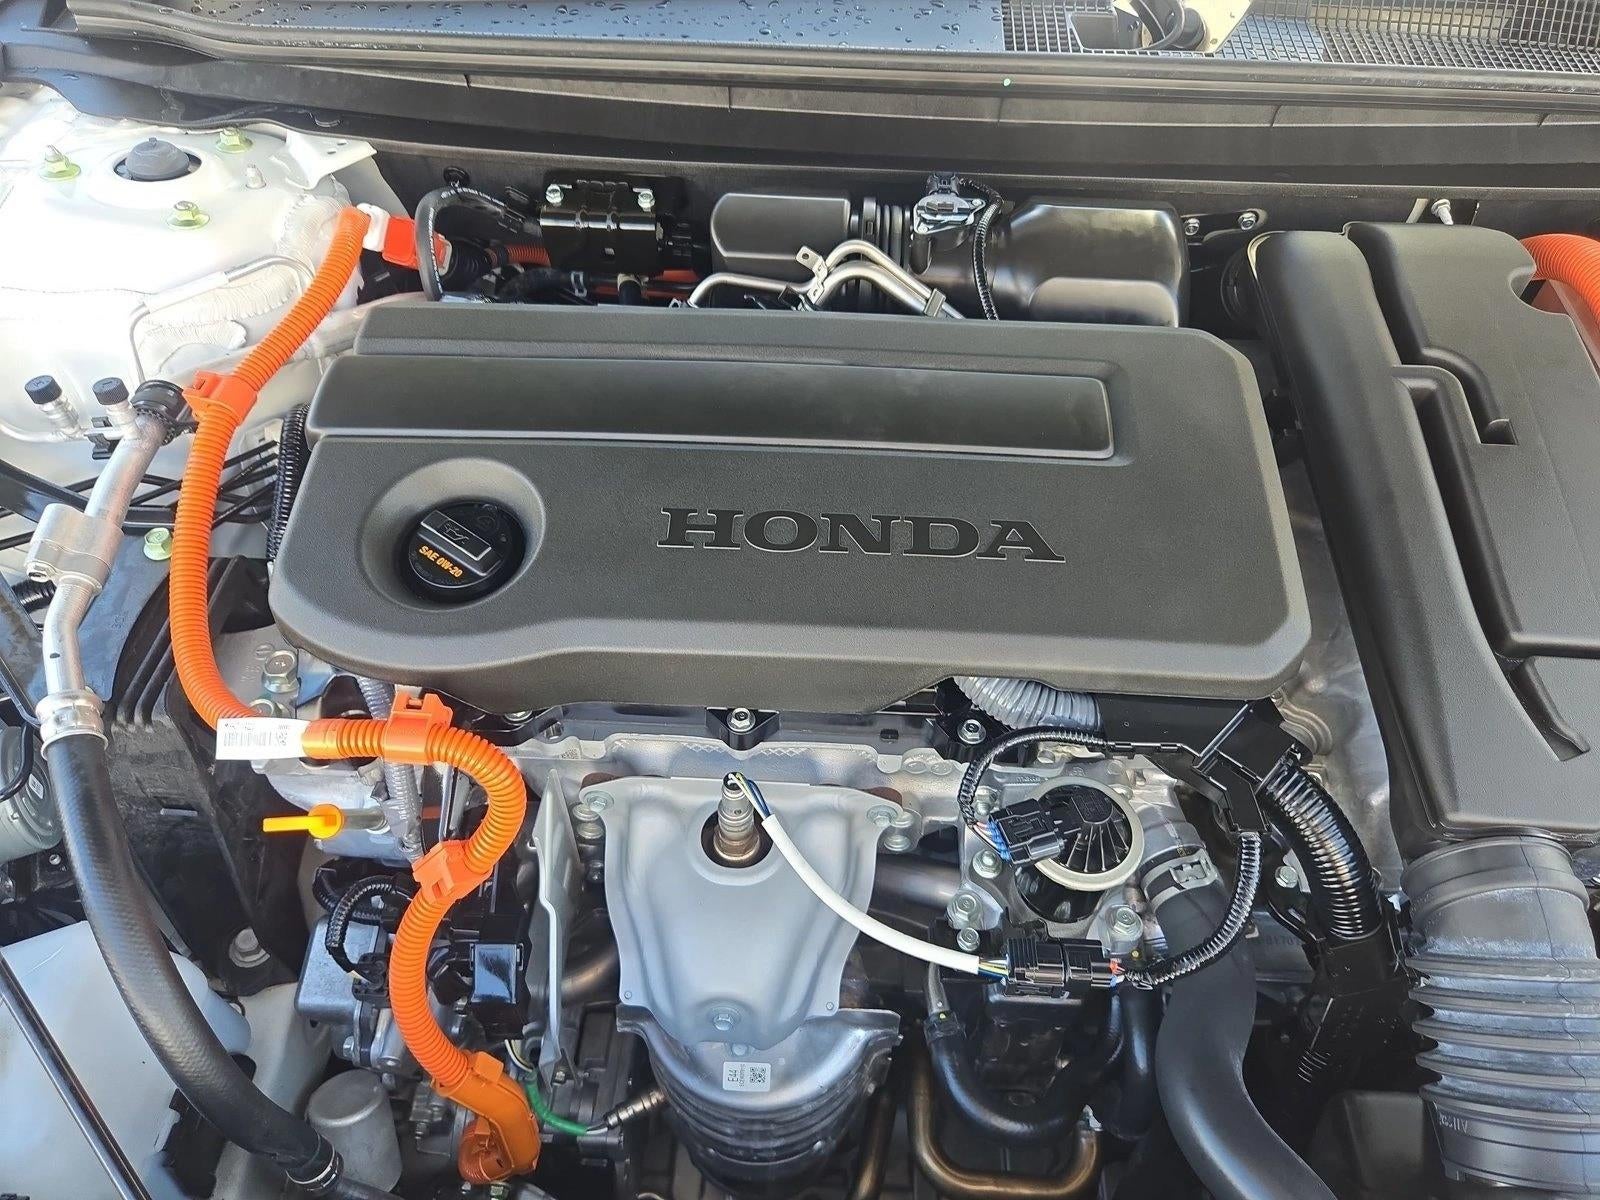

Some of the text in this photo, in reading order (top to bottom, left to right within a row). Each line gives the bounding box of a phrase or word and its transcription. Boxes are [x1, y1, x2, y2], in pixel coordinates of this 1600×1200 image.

[657, 507, 1066, 563] HONDA
[419, 545, 463, 578] SAE 0W-20
